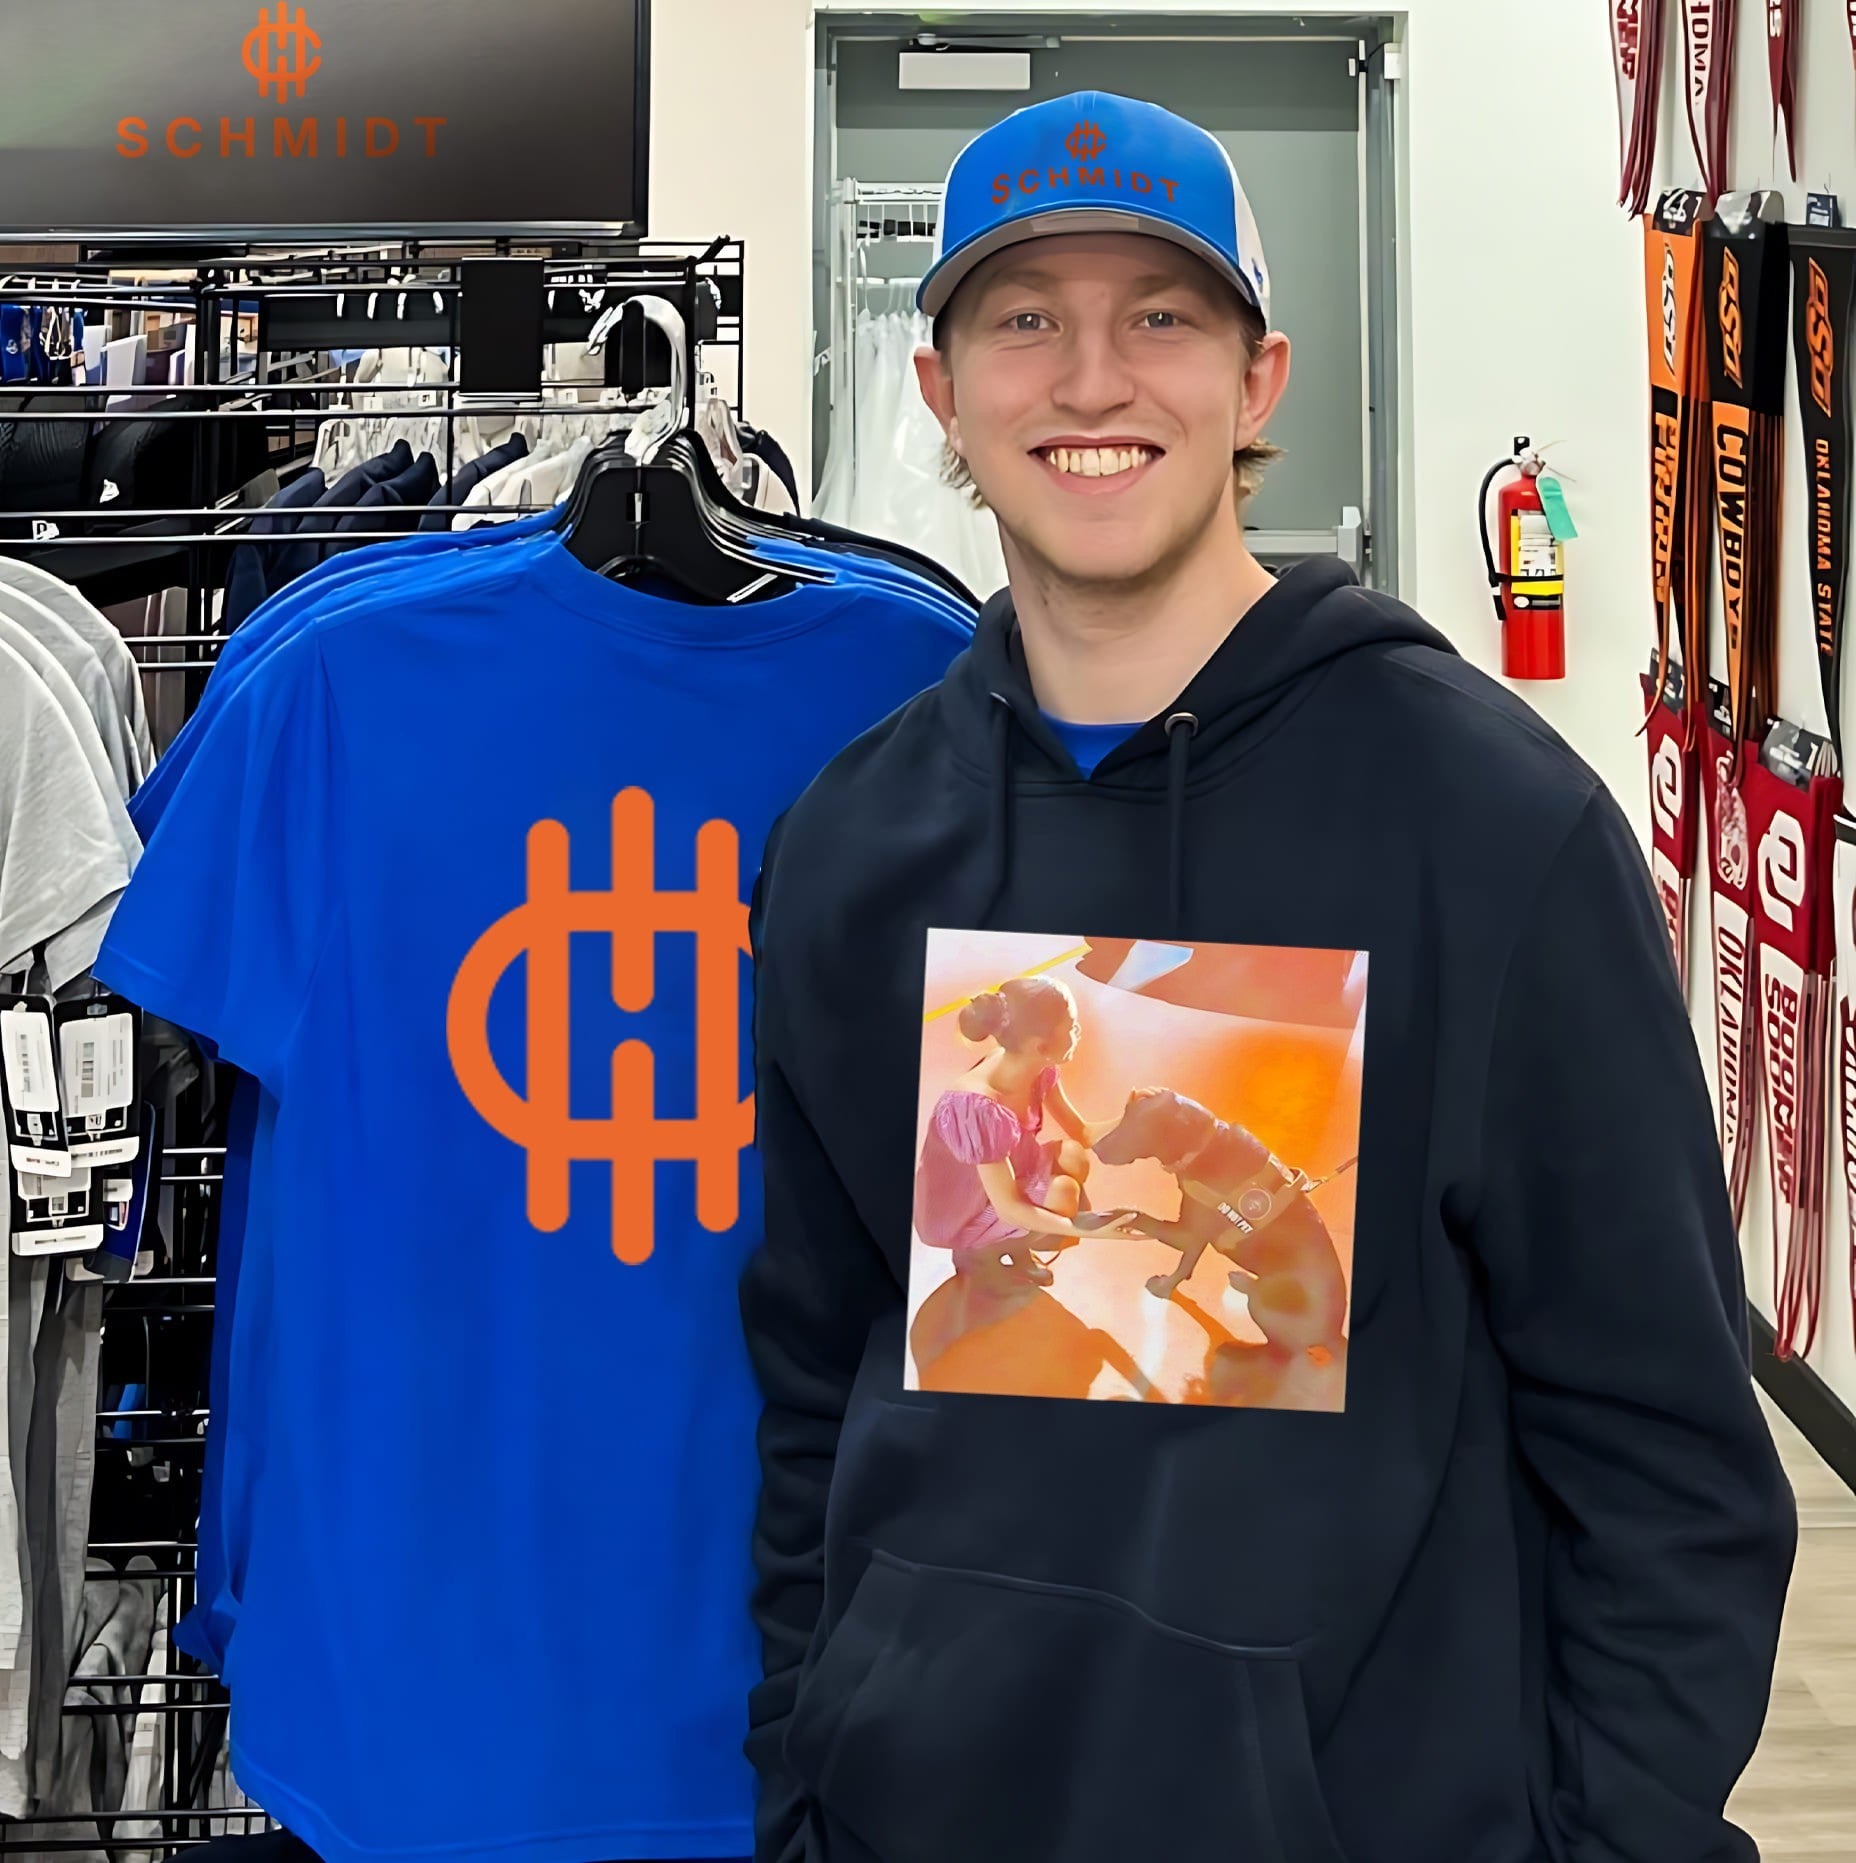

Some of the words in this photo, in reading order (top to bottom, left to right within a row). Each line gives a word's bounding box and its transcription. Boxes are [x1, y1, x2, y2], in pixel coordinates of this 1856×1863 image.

[115, 116, 447, 159] SCHMIDT
[991, 167, 1179, 205] SCHMIDT
[1806, 257, 1833, 419] OSU
[1716, 423, 1750, 650] COWBOY
[1815, 438, 1832, 570] OKLAHOMA
[1757, 809, 1806, 933] OU
[1718, 925, 1745, 1144] OKLAHOMA
[1237, 1220, 1253, 1233] PET
